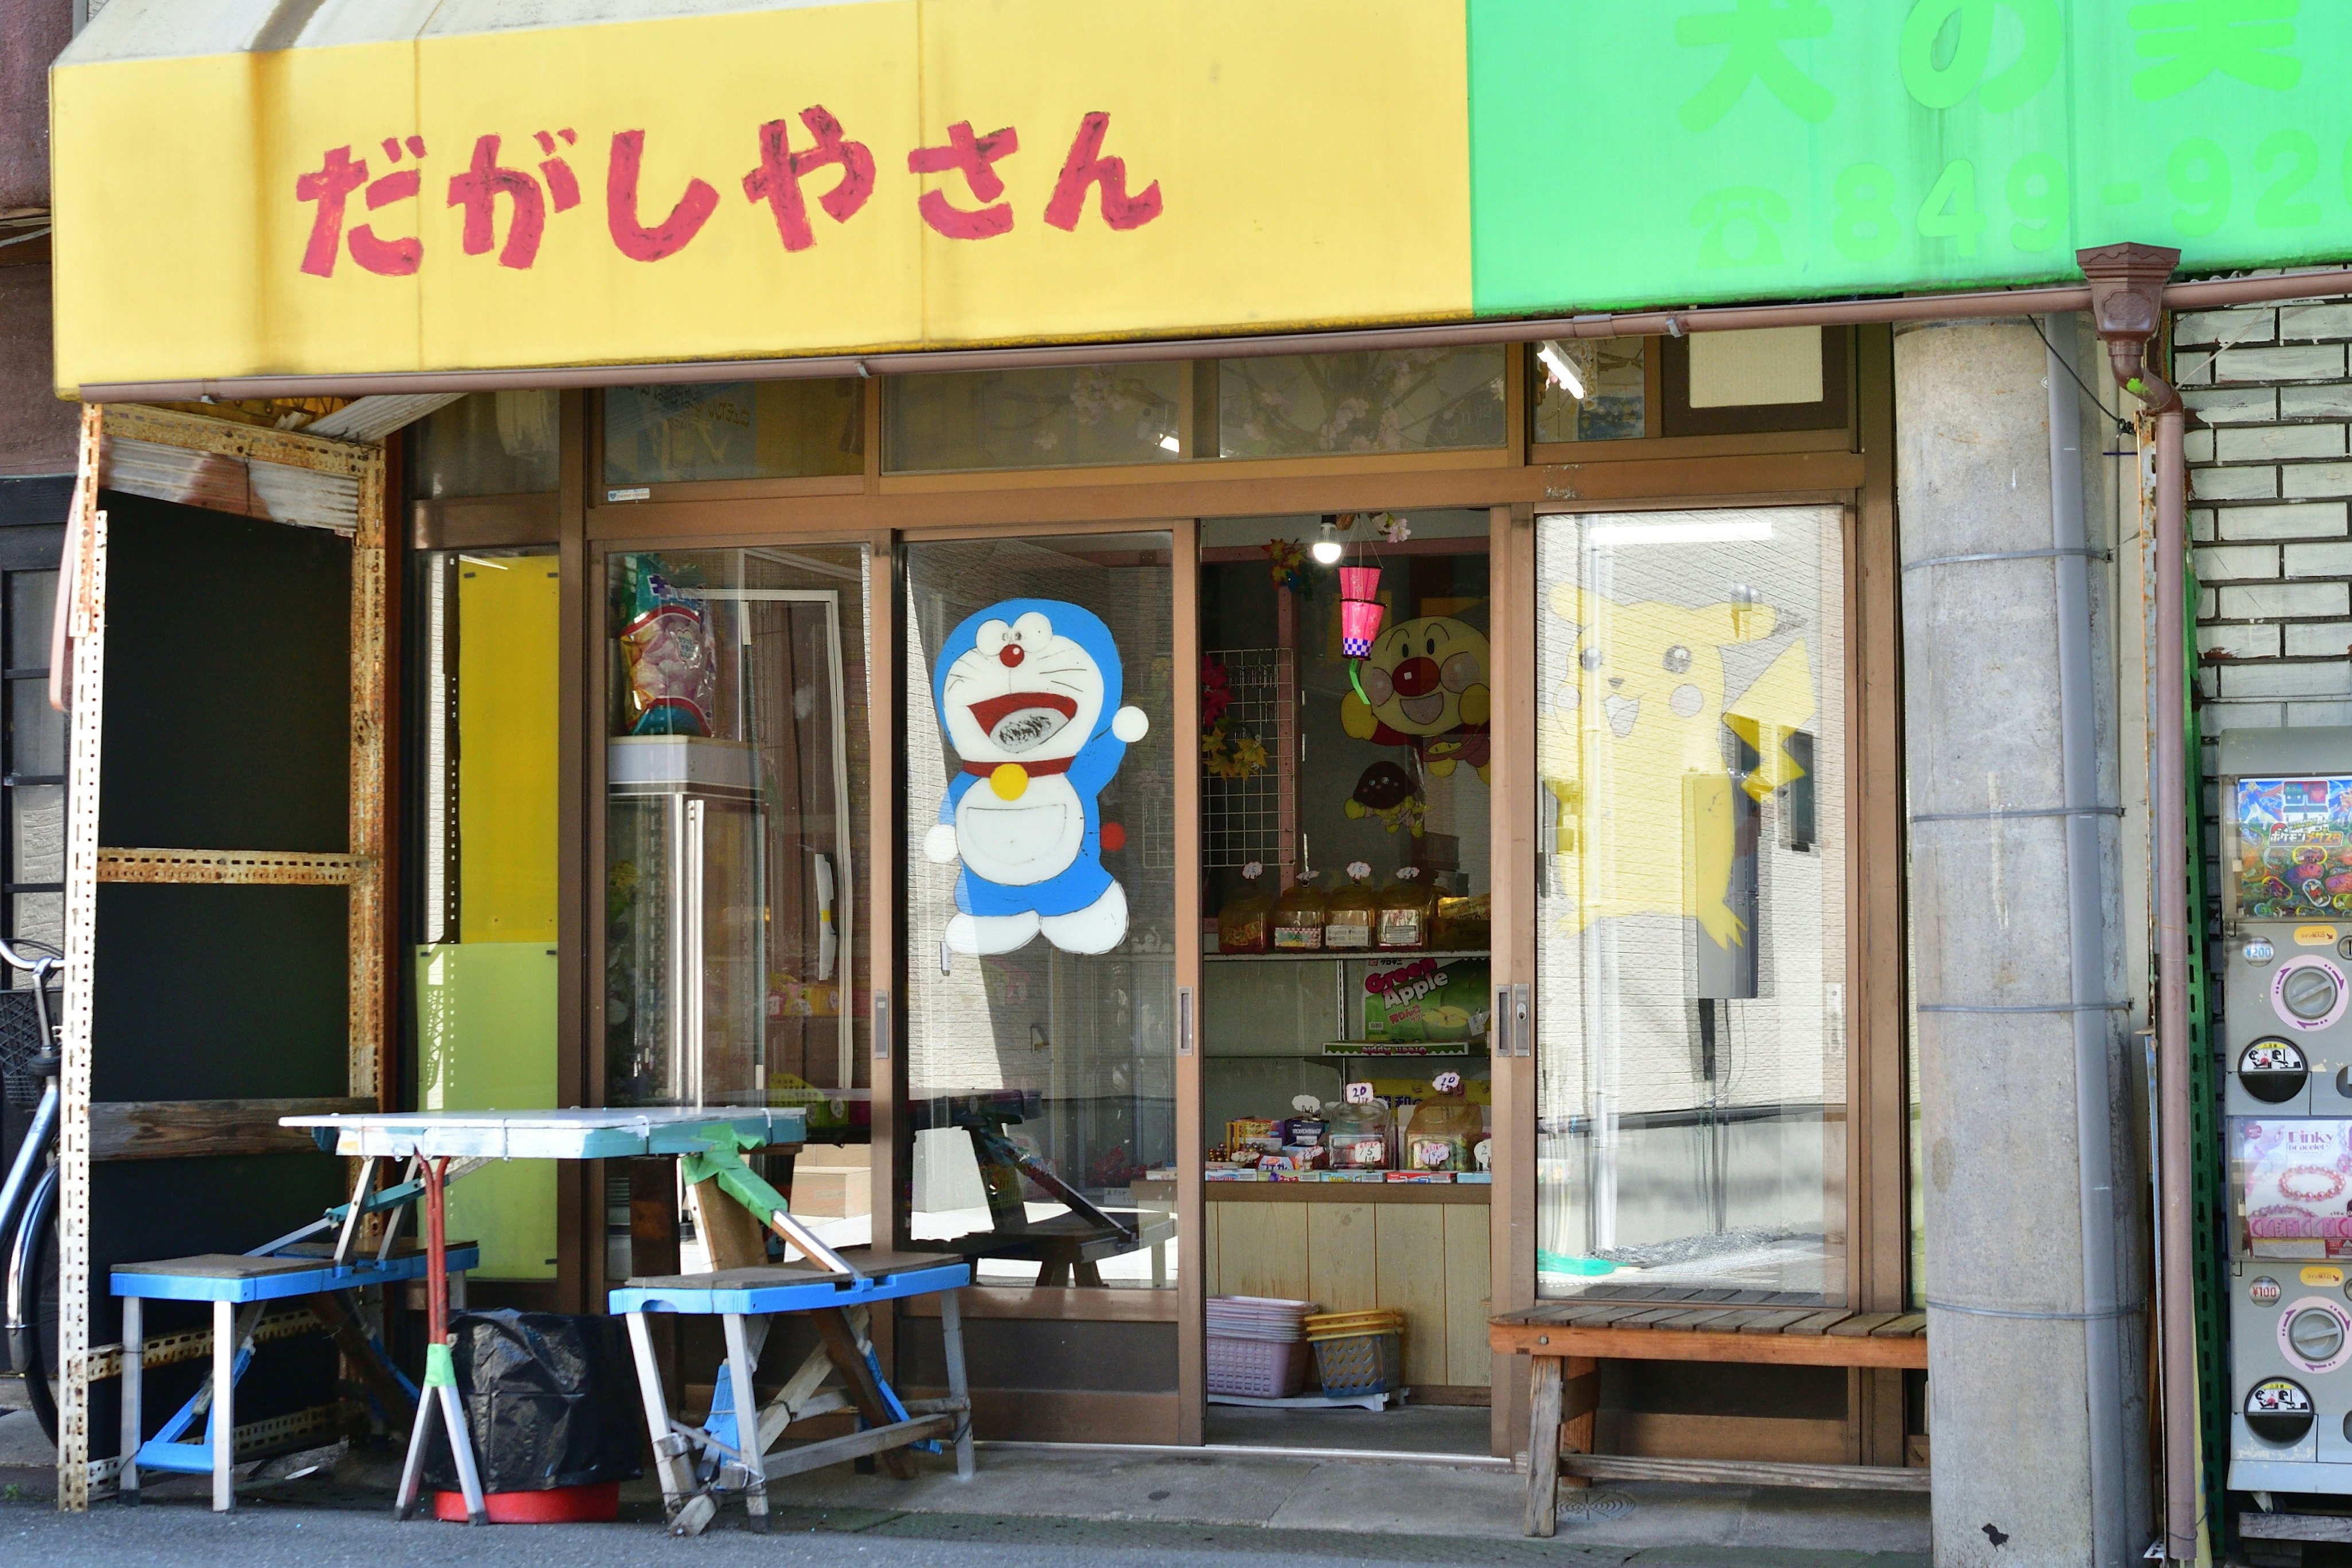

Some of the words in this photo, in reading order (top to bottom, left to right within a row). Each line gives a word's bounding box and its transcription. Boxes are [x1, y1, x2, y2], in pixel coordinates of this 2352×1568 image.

[298, 105, 1160, 276] だがしやさん
[1832, 129, 2352, 262] 849-92
[2246, 947, 2272, 958] ¥200
[1365, 957, 1438, 994] Green
[1382, 972, 1449, 1011] Apple
[1362, 1045, 1393, 1056] Apple
[1395, 1046, 1427, 1056] Green
[1352, 1086, 1367, 1098] 20
[2288, 1129, 2334, 1144] Pinky
[2252, 1286, 2277, 1298] ¥100
